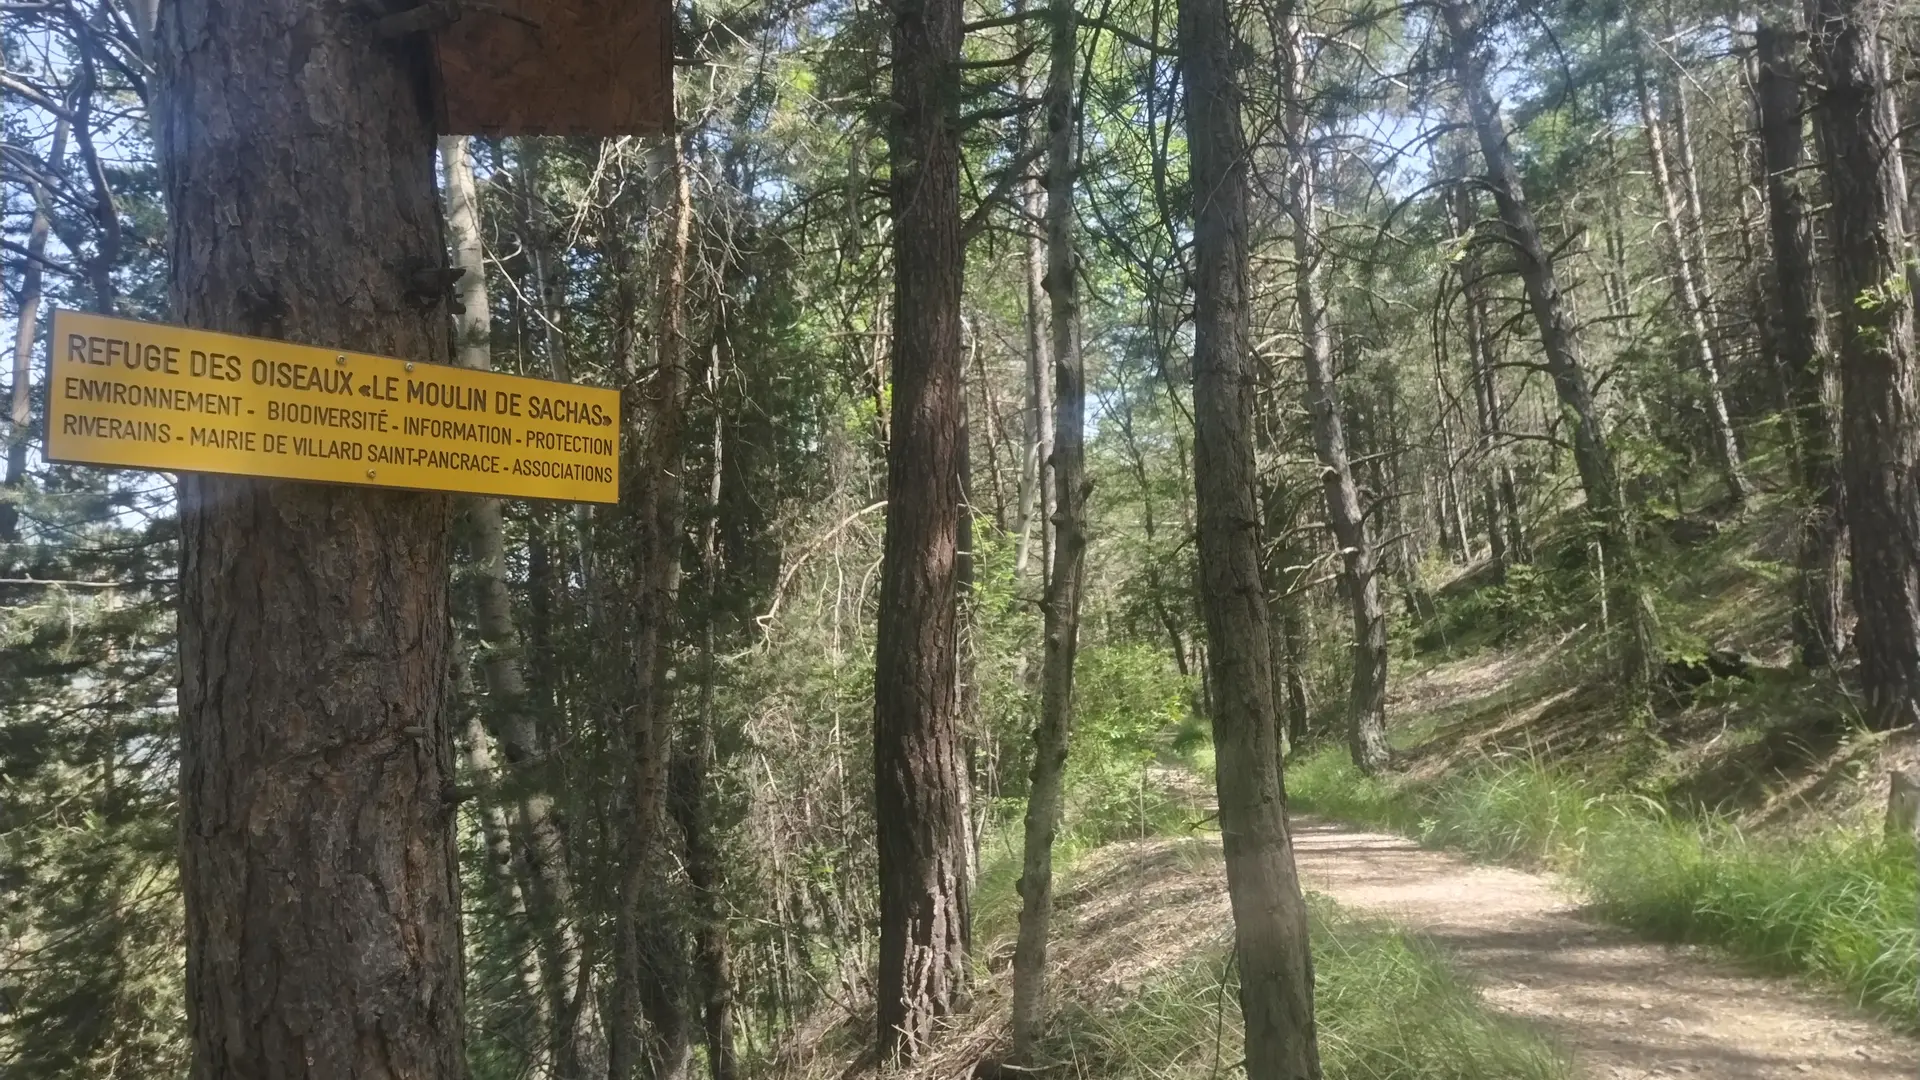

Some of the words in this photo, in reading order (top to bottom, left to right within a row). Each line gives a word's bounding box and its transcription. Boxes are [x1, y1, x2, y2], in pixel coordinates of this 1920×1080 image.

[67, 333, 181, 375] REFUGE
[189, 350, 242, 382] DES
[251, 359, 353, 396] OISEAUX
[407, 379, 487, 412] MOULIN
[495, 391, 521, 416] DE
[63, 413, 171, 443] RIVERAINS
[190, 426, 256, 451] MAIRIE
[263, 434, 288, 454] DE
[293, 437, 362, 461] VILLARD
[367, 444, 500, 473] SAINT-PANCRACE
[512, 458, 613, 483] ASSOCIATIONS
[64, 377, 242, 416] ENVIRONNEMENT
[267, 400, 388, 432] BIODIVERSITÉ
[403, 416, 512, 445] INFORMATION
[526, 430, 613, 456] PROTECTION
